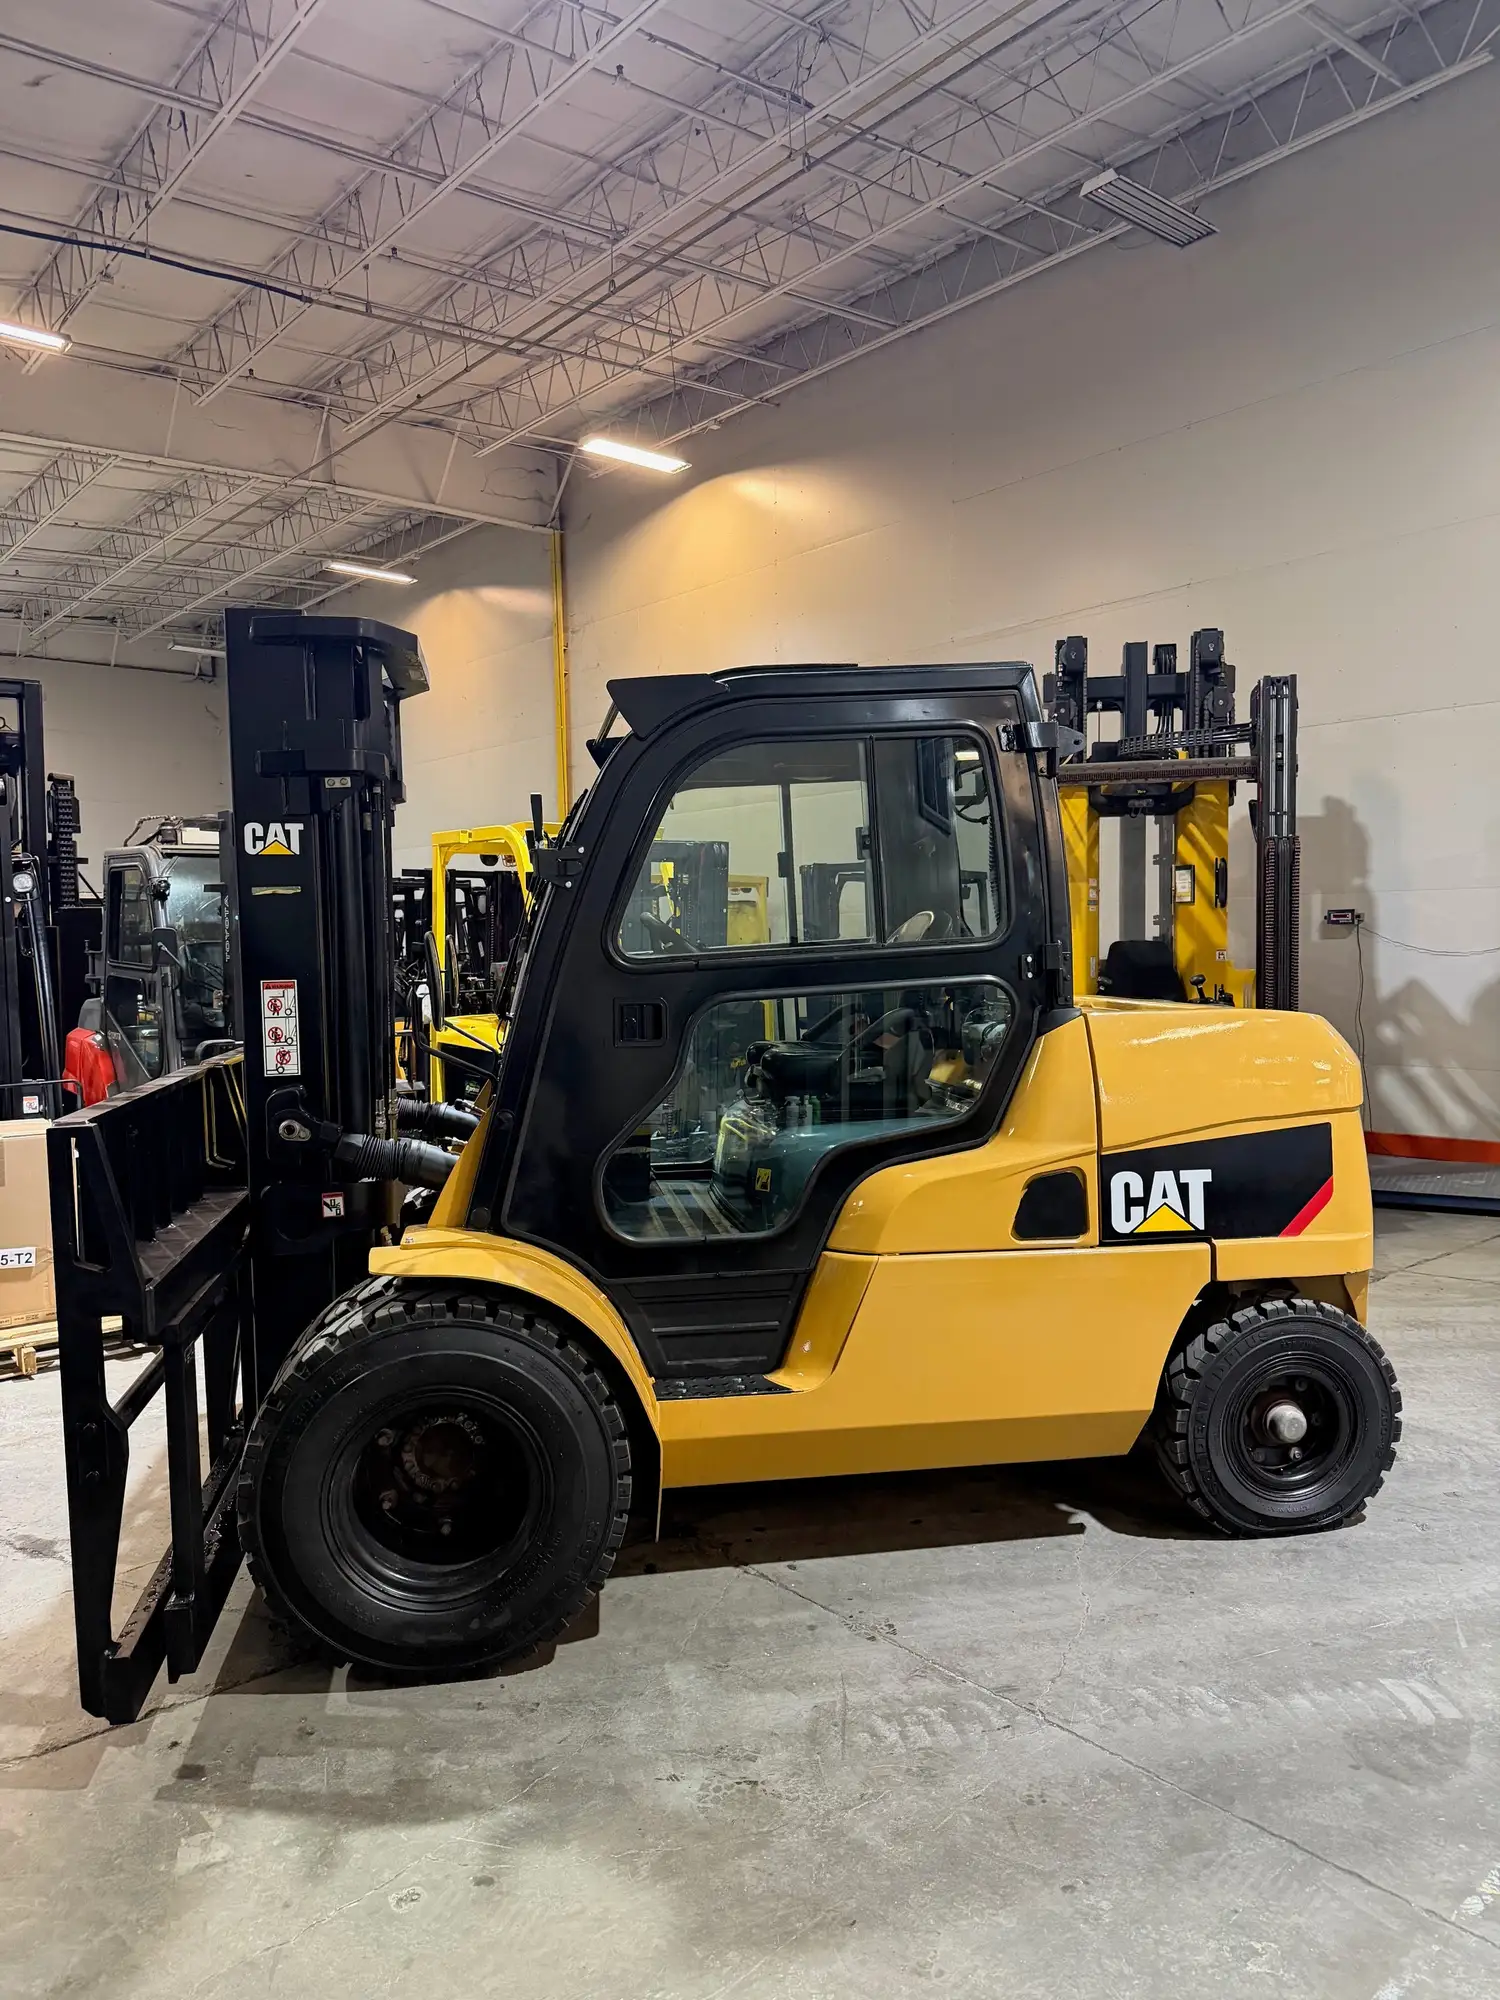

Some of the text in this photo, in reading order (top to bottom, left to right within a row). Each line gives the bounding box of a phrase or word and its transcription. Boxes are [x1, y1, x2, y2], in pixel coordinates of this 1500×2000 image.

[243, 822, 304, 855] CAT
[223, 895, 231, 962] TOYOTA
[1110, 1169, 1212, 1234] CAT
